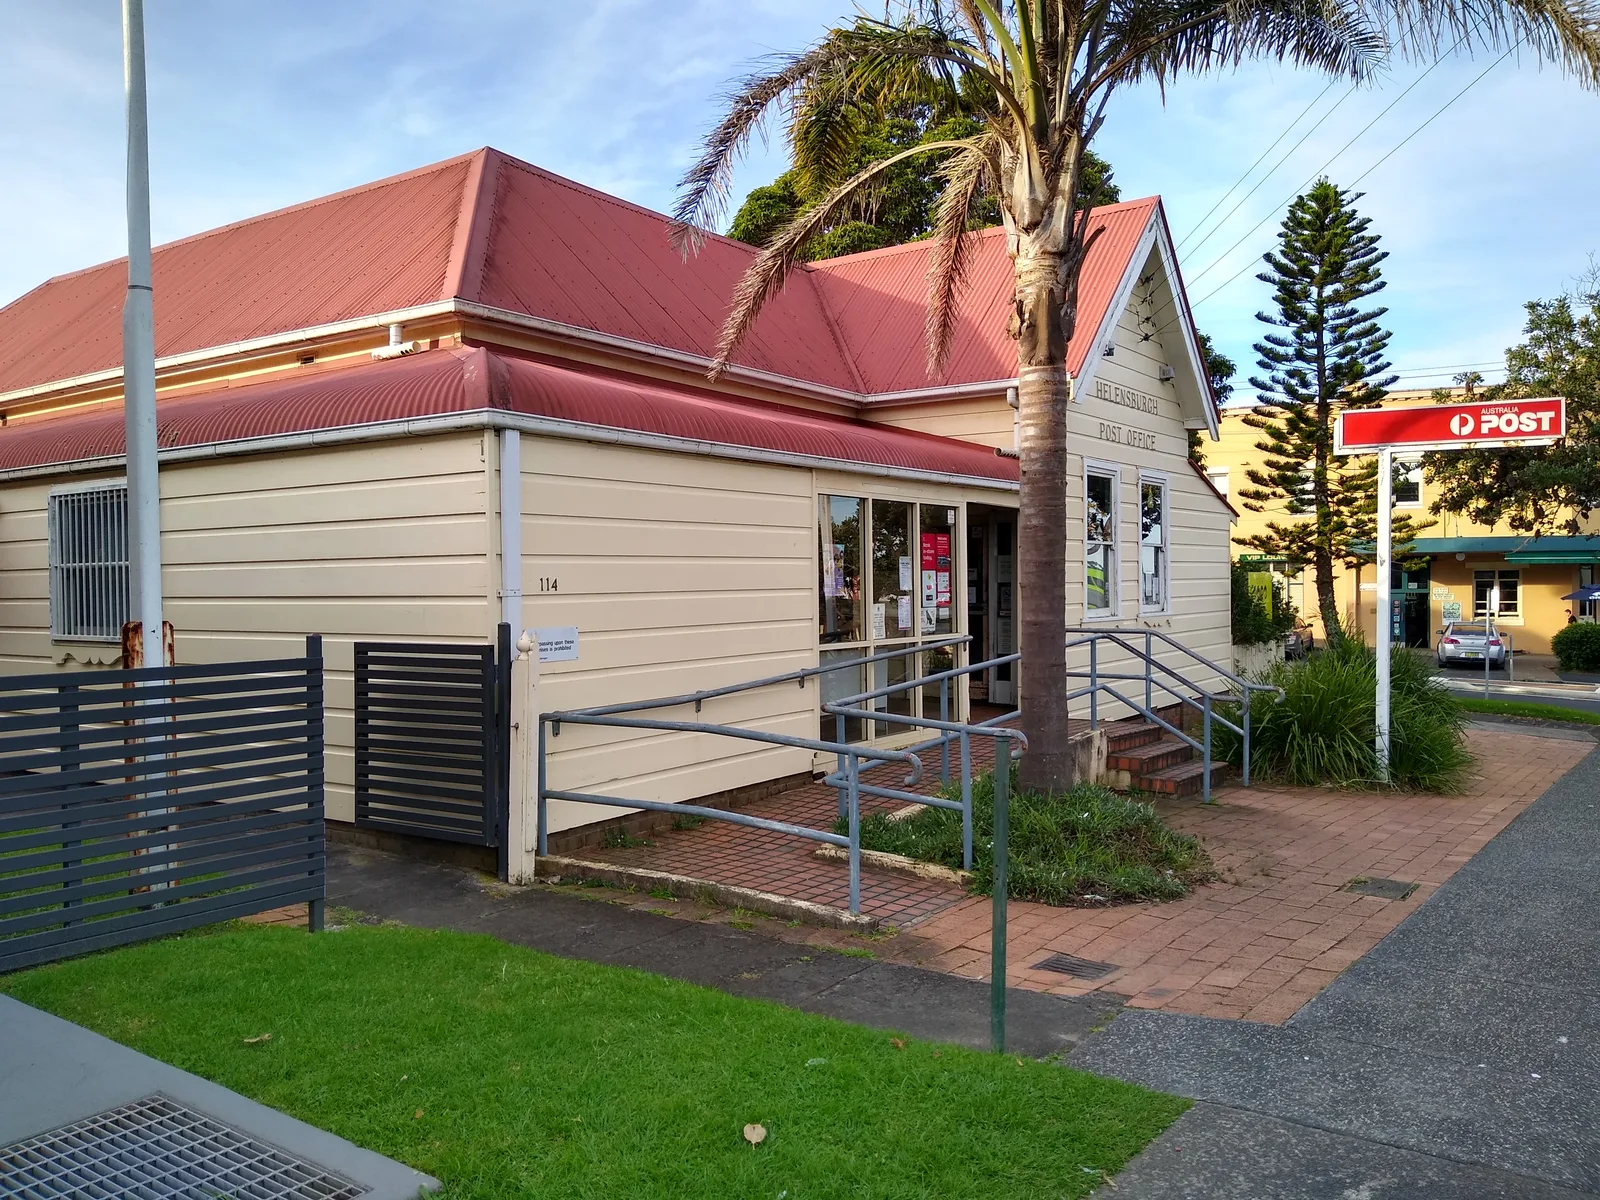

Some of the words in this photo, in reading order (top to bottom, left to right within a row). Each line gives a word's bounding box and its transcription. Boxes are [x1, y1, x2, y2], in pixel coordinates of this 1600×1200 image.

[1096, 380, 1159, 416] HELENSBURGH
[1481, 406, 1519, 415] AUSTRALIA
[1480, 411, 1555, 434] POST
[1099, 422, 1122, 444] POST
[1126, 429, 1156, 451] OFFICE
[539, 577, 558, 592] 114
